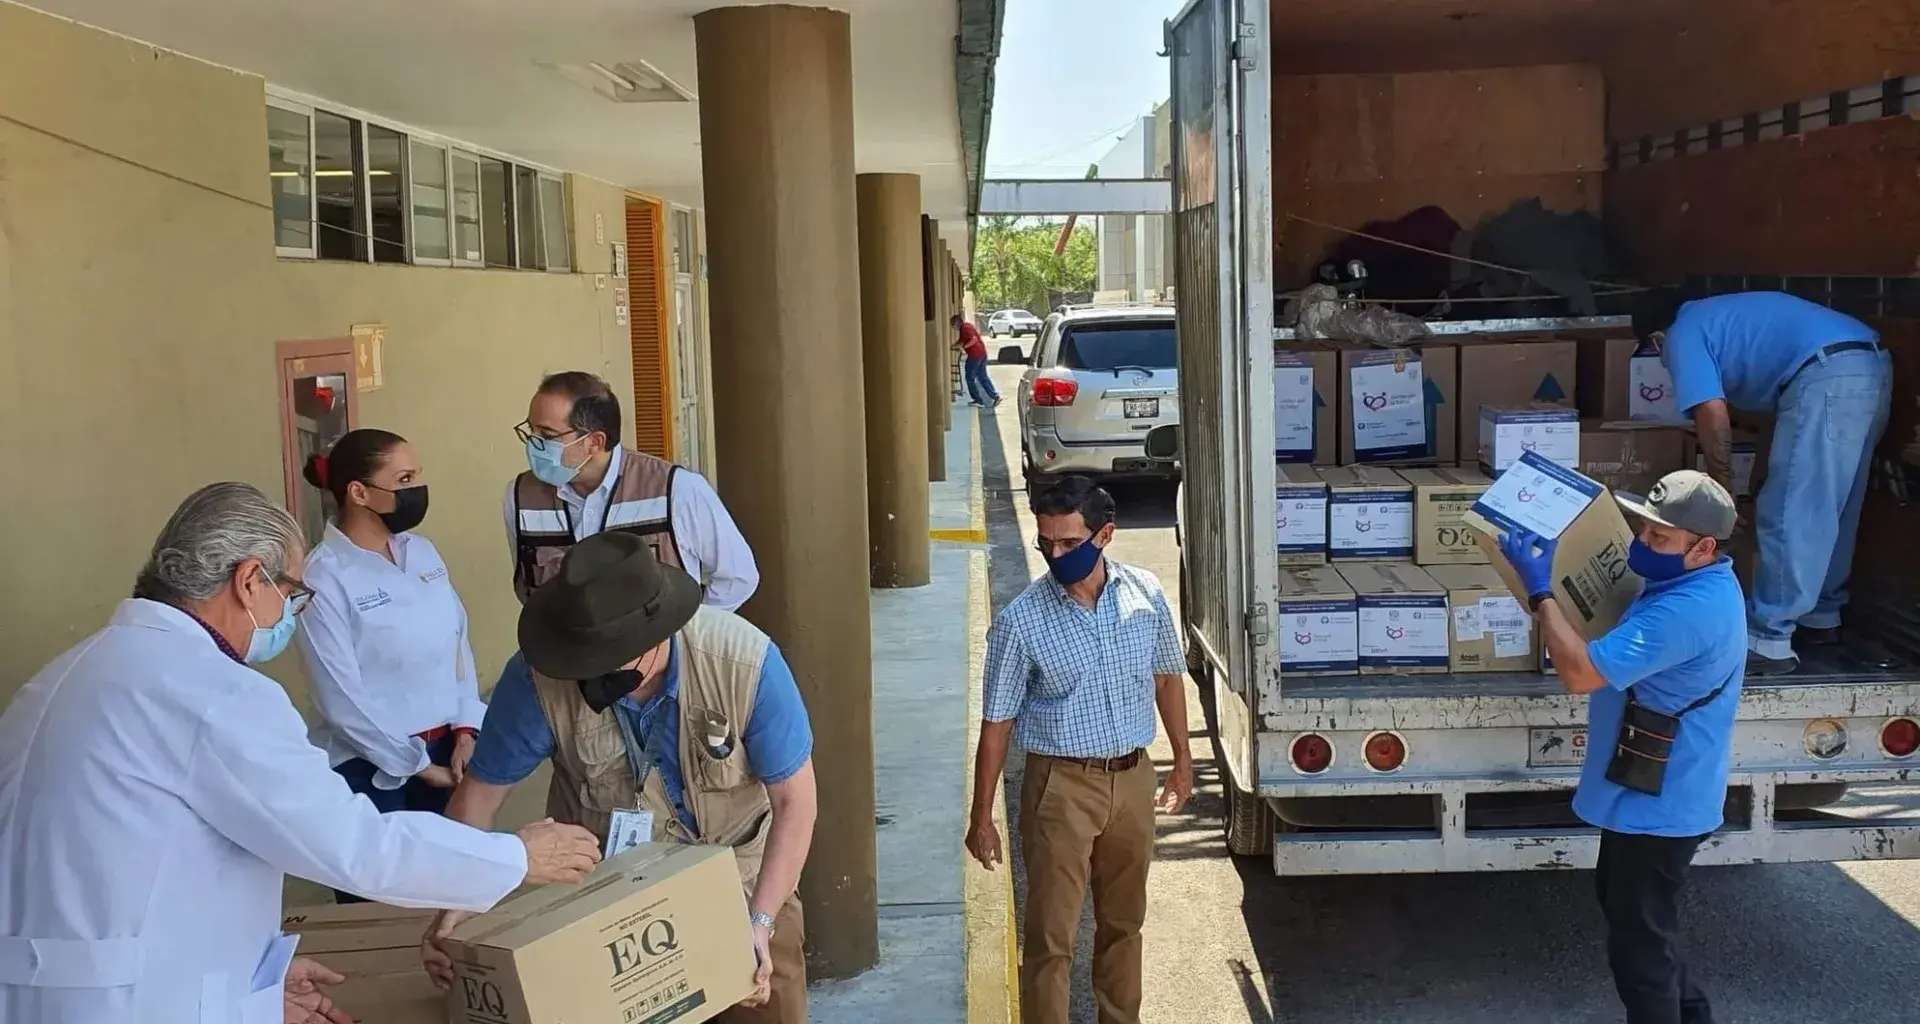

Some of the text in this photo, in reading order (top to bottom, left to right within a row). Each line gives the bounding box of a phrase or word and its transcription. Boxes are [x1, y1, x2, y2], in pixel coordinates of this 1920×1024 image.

[1597, 540, 1628, 585] EQ
[603, 919, 679, 979] EQ
[461, 975, 508, 1020] EQ
